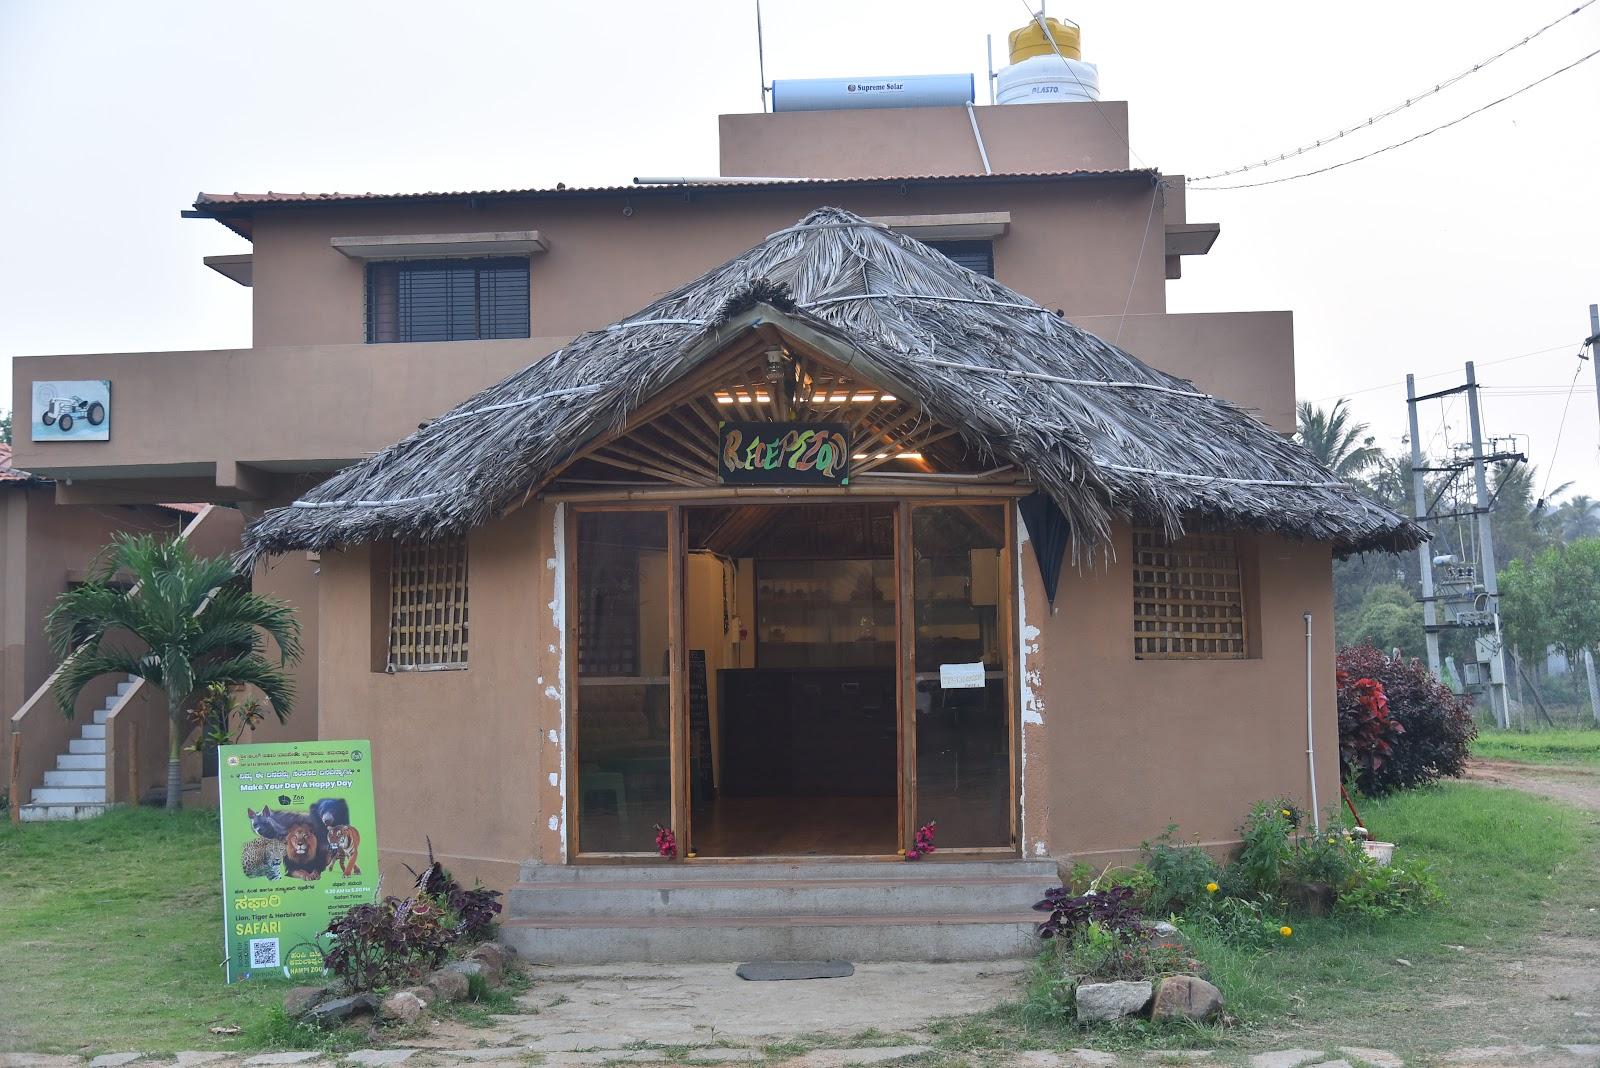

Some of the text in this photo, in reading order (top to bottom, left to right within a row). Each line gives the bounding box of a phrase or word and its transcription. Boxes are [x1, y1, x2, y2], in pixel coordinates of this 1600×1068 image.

[857, 84, 885, 92] Supreme
[240, 784, 263, 792] Make
[284, 782, 300, 790] Day
[309, 781, 335, 789] Happy
[336, 780, 352, 788] Day
[235, 895, 280, 911] ಸಫಾರಿ
[236, 921, 280, 936] SAFARI
